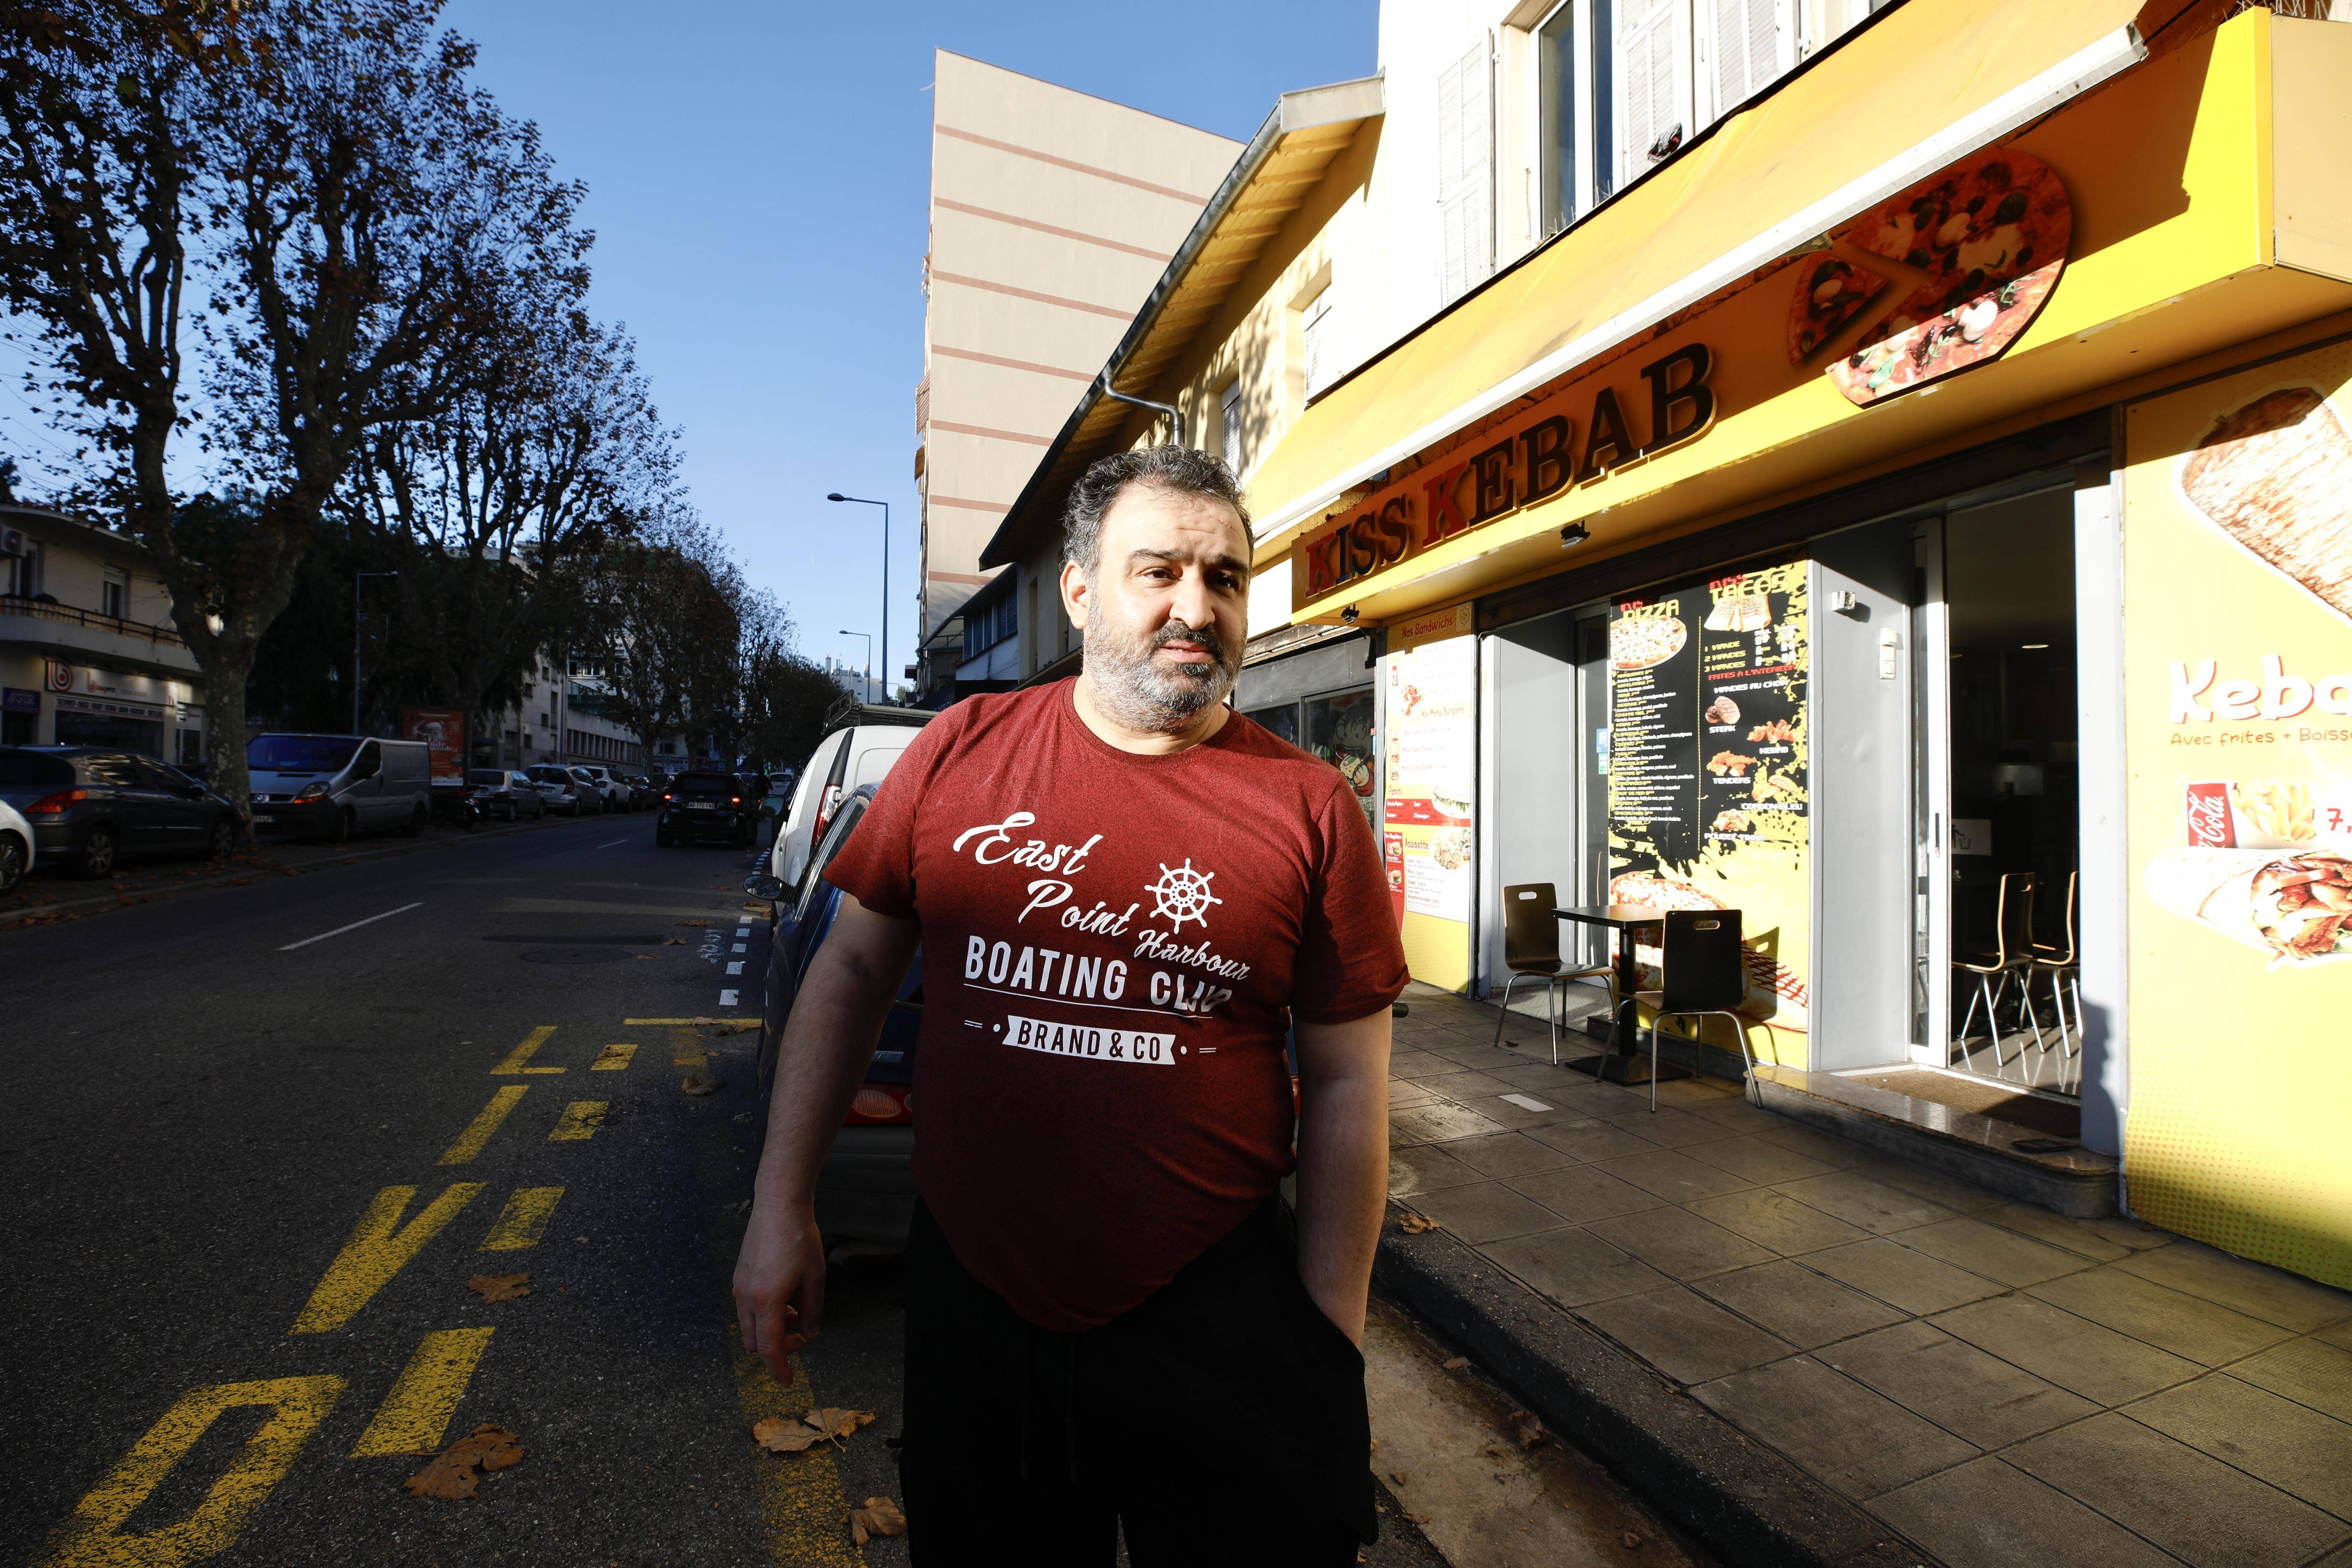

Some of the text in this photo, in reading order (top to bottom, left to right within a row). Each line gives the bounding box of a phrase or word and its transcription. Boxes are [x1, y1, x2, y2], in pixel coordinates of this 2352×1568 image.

[1305, 342, 1717, 598] KISS KEBAB
[1709, 571, 1789, 605] TACOS
[1623, 599, 1679, 624] PIZZA
[1402, 626, 1414, 640] Nos
[1415, 615, 1453, 636] Sandwichs
[1712, 641, 1740, 651] VIANDE
[1712, 650, 1746, 661] VIANDES
[1708, 671, 1736, 680] FRITES
[1745, 664, 1796, 676] L'INTERIEUR
[1712, 661, 1746, 672] VIANDES
[1714, 679, 1790, 694] VIANDES AU CHOIX
[1443, 707, 1464, 717] Burgers
[1709, 724, 1736, 734] STEAK
[2170, 733, 2212, 746] Avec
[2220, 730, 2275, 747] frites
[2299, 728, 2352, 742] Boiss
[1759, 746, 1789, 755] KEBAB
[1389, 786, 1402, 796] Panini
[1741, 802, 1803, 811] CORDON BLEU
[953, 811, 1104, 876] East
[1405, 838, 1429, 850] Assisette
[1017, 879, 1141, 937] Point
[1133, 929, 1250, 980] Harbour
[964, 935, 1128, 1001] BOATING
[1017, 1020, 1161, 1062] BRAND & CO
